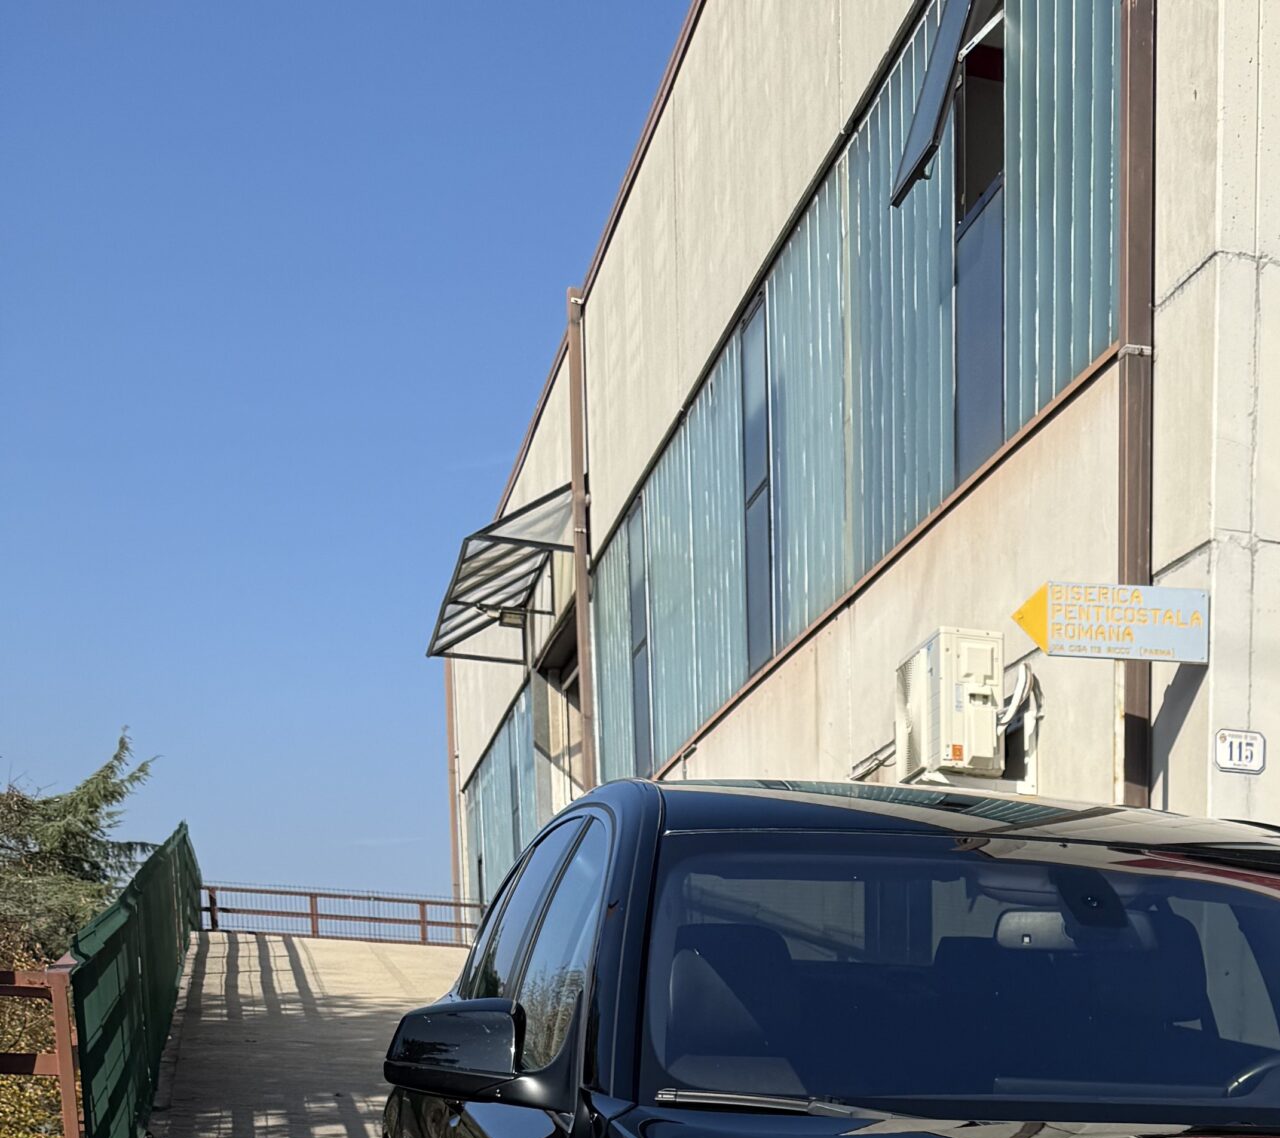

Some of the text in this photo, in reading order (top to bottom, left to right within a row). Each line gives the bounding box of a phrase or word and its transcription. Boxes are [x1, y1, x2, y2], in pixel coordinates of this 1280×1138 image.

[1051, 585, 1143, 605] BISERICA
[1051, 603, 1204, 629] PENTICOSTALA
[1051, 623, 1135, 642] ROMANA
[1229, 740, 1254, 763] 115
